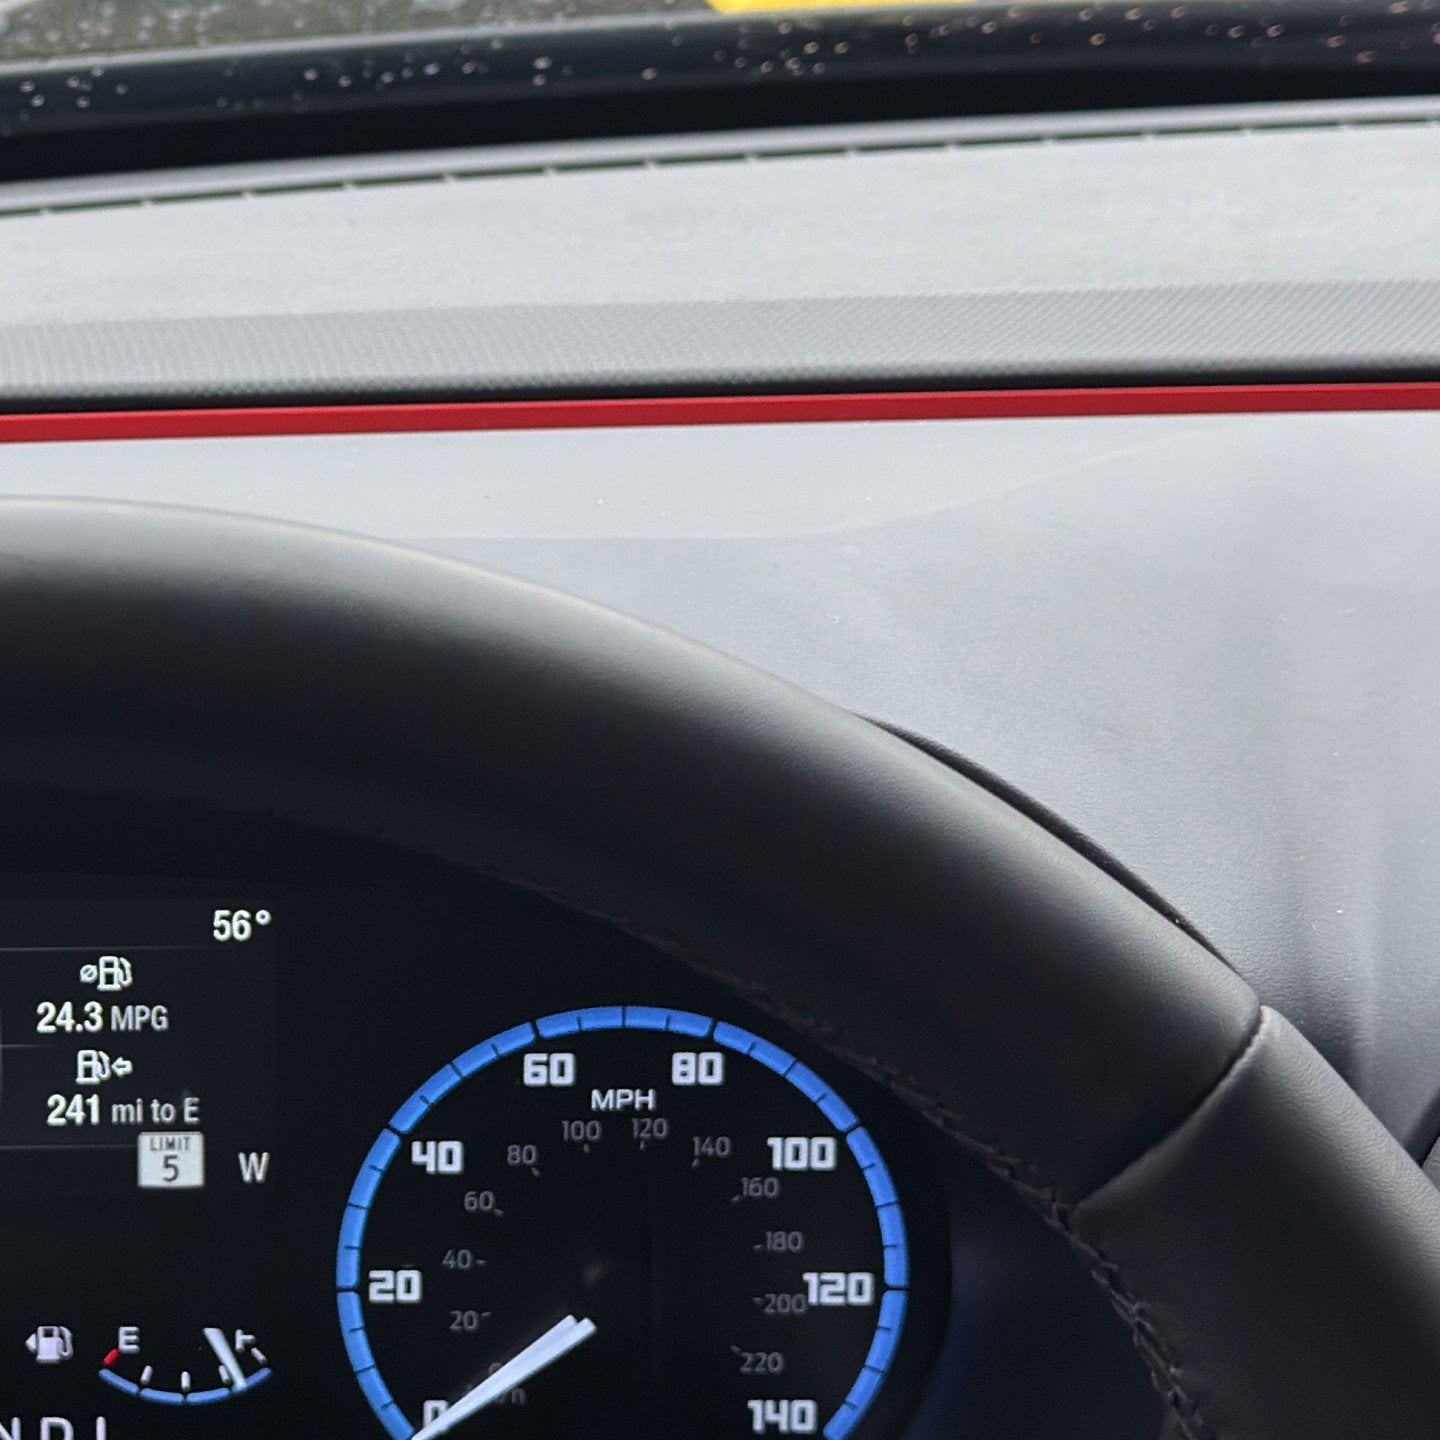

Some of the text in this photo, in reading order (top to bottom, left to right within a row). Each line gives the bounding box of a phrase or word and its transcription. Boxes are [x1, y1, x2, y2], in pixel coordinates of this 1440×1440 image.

[212, 909, 271, 942] 56°
[36, 1000, 169, 1033] 24.3 MPG
[523, 1052, 575, 1086] 60
[672, 1052, 723, 1085] 80
[46, 1093, 199, 1126] 241 mi to E
[591, 1088, 655, 1111] MPH
[561, 1119, 603, 1141] 100
[630, 1117, 669, 1138] 120
[149, 1136, 191, 1151] LIMIT
[506, 1144, 538, 1165] 80
[692, 1135, 732, 1157] 140
[767, 1136, 836, 1170] 100
[162, 1154, 179, 1182] 5
[237, 1151, 270, 1183] W
[411, 1140, 463, 1174] 40
[741, 1177, 781, 1198] 160
[463, 1191, 496, 1212] 60
[764, 1230, 804, 1252] 180
[441, 1249, 473, 1269] 40
[369, 1269, 421, 1303] 20
[802, 1272, 873, 1305] 120
[762, 1293, 807, 1314] 200
[449, 1310, 478, 1330] 20
[118, 1326, 139, 1352] E
[739, 1352, 785, 1374] 220
[747, 1399, 817, 1433] 140
